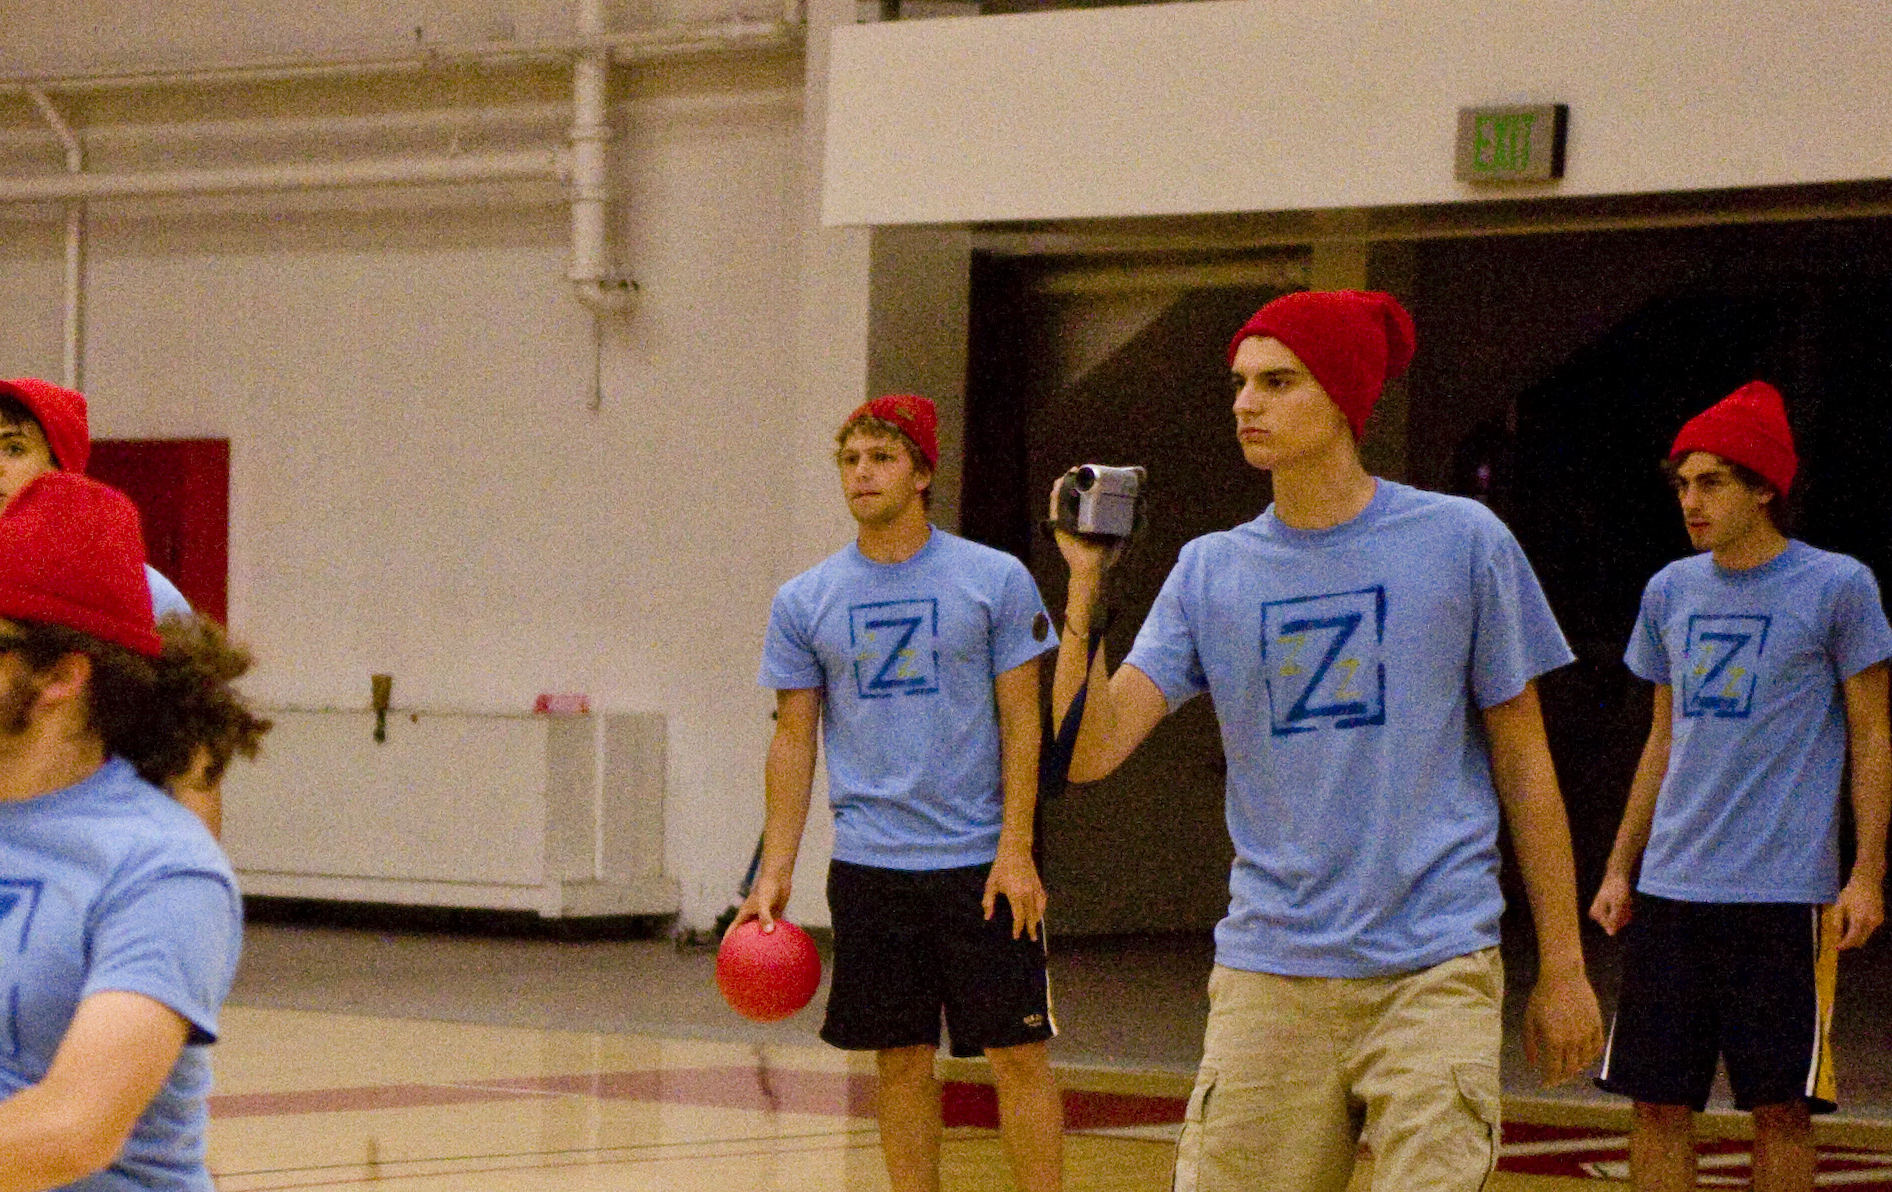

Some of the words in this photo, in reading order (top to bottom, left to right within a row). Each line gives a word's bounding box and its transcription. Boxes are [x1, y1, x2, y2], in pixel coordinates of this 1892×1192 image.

[1473, 112, 1536, 171] EXIT
[866, 616, 926, 689] Z
[1281, 613, 1366, 722] Z
[1692, 632, 1752, 709] Z
